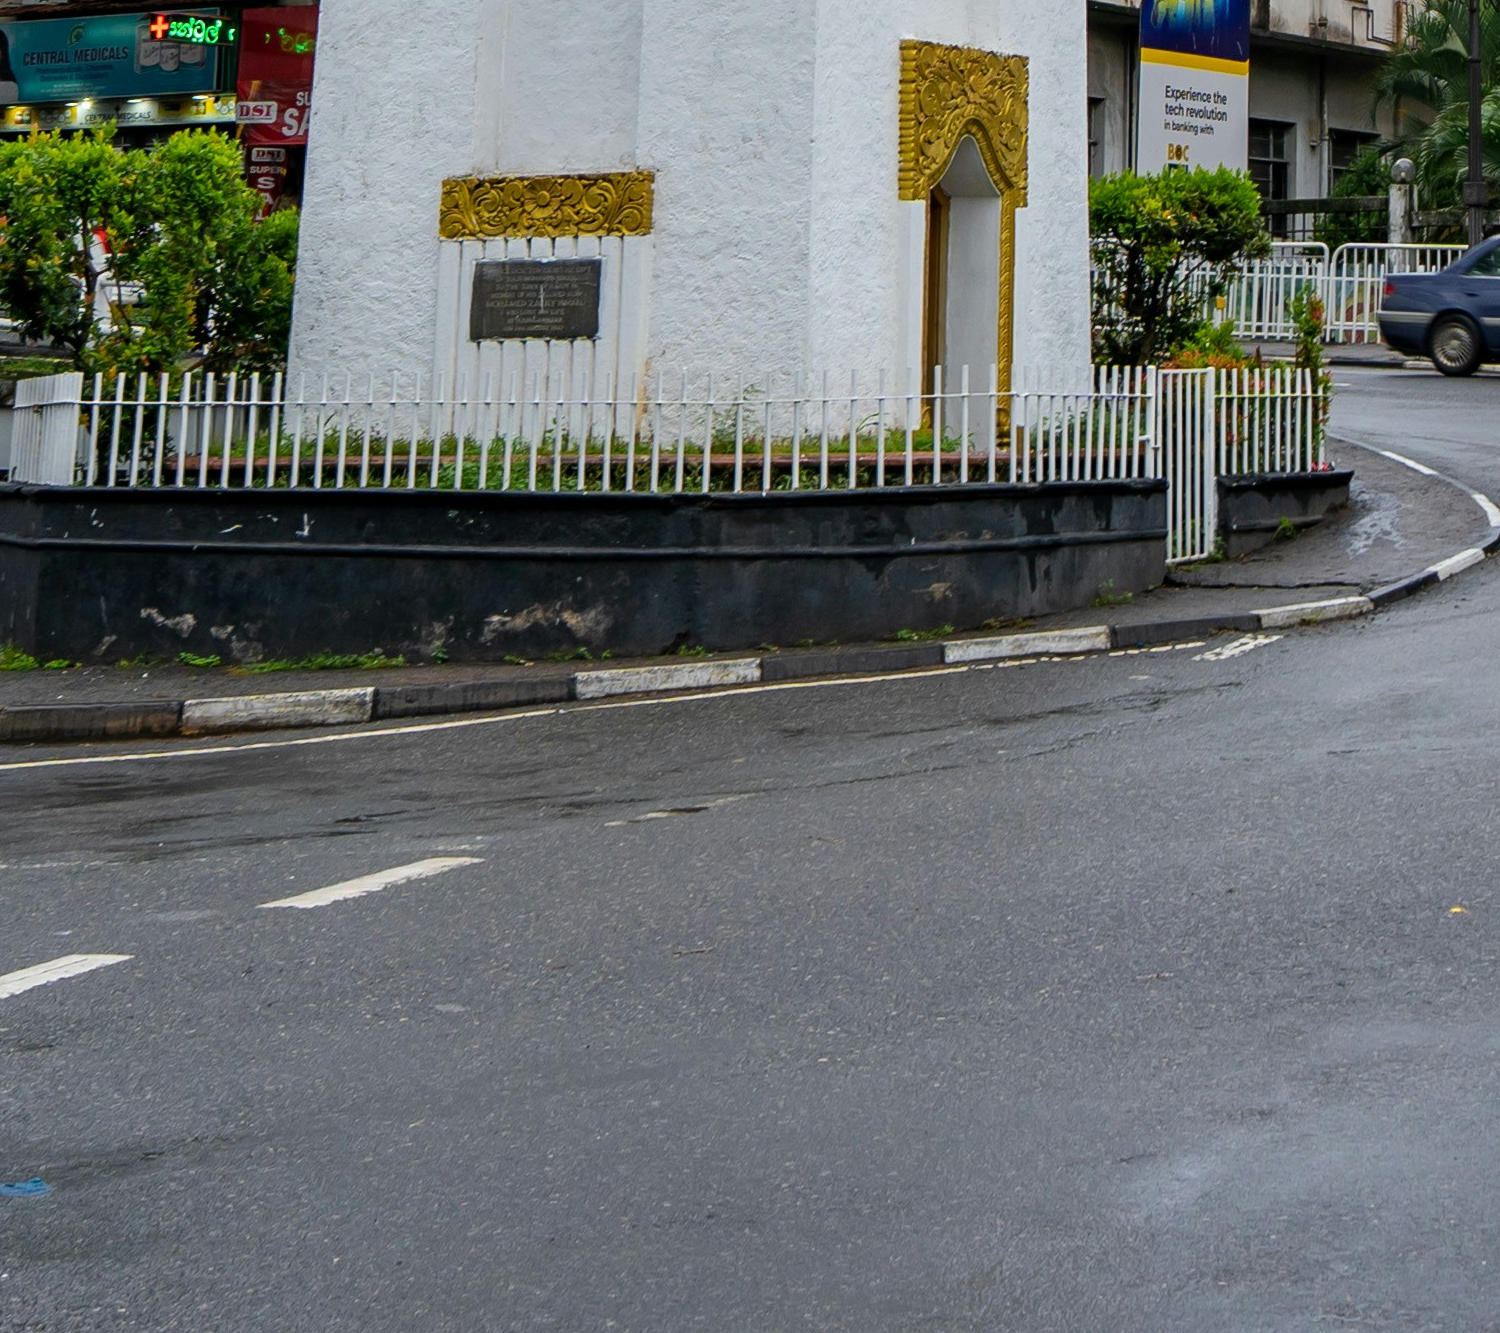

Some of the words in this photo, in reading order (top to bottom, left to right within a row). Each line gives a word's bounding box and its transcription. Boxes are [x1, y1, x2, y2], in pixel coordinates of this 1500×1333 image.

[23, 51, 70, 66] CENTRAL
[74, 46, 128, 62] MEDICALS
[1165, 85, 1211, 103] Experience
[1213, 91, 1227, 105] the
[239, 104, 273, 117] DSI
[1165, 103, 1184, 117] tech
[1186, 106, 1228, 122] revolution
[1164, 119, 1171, 130] in
[1172, 120, 1198, 135] banking
[1200, 123, 1214, 135] with
[255, 149, 281, 159] DSI
[1167, 143, 1189, 162] BOC
[250, 166, 283, 175] SUPER
